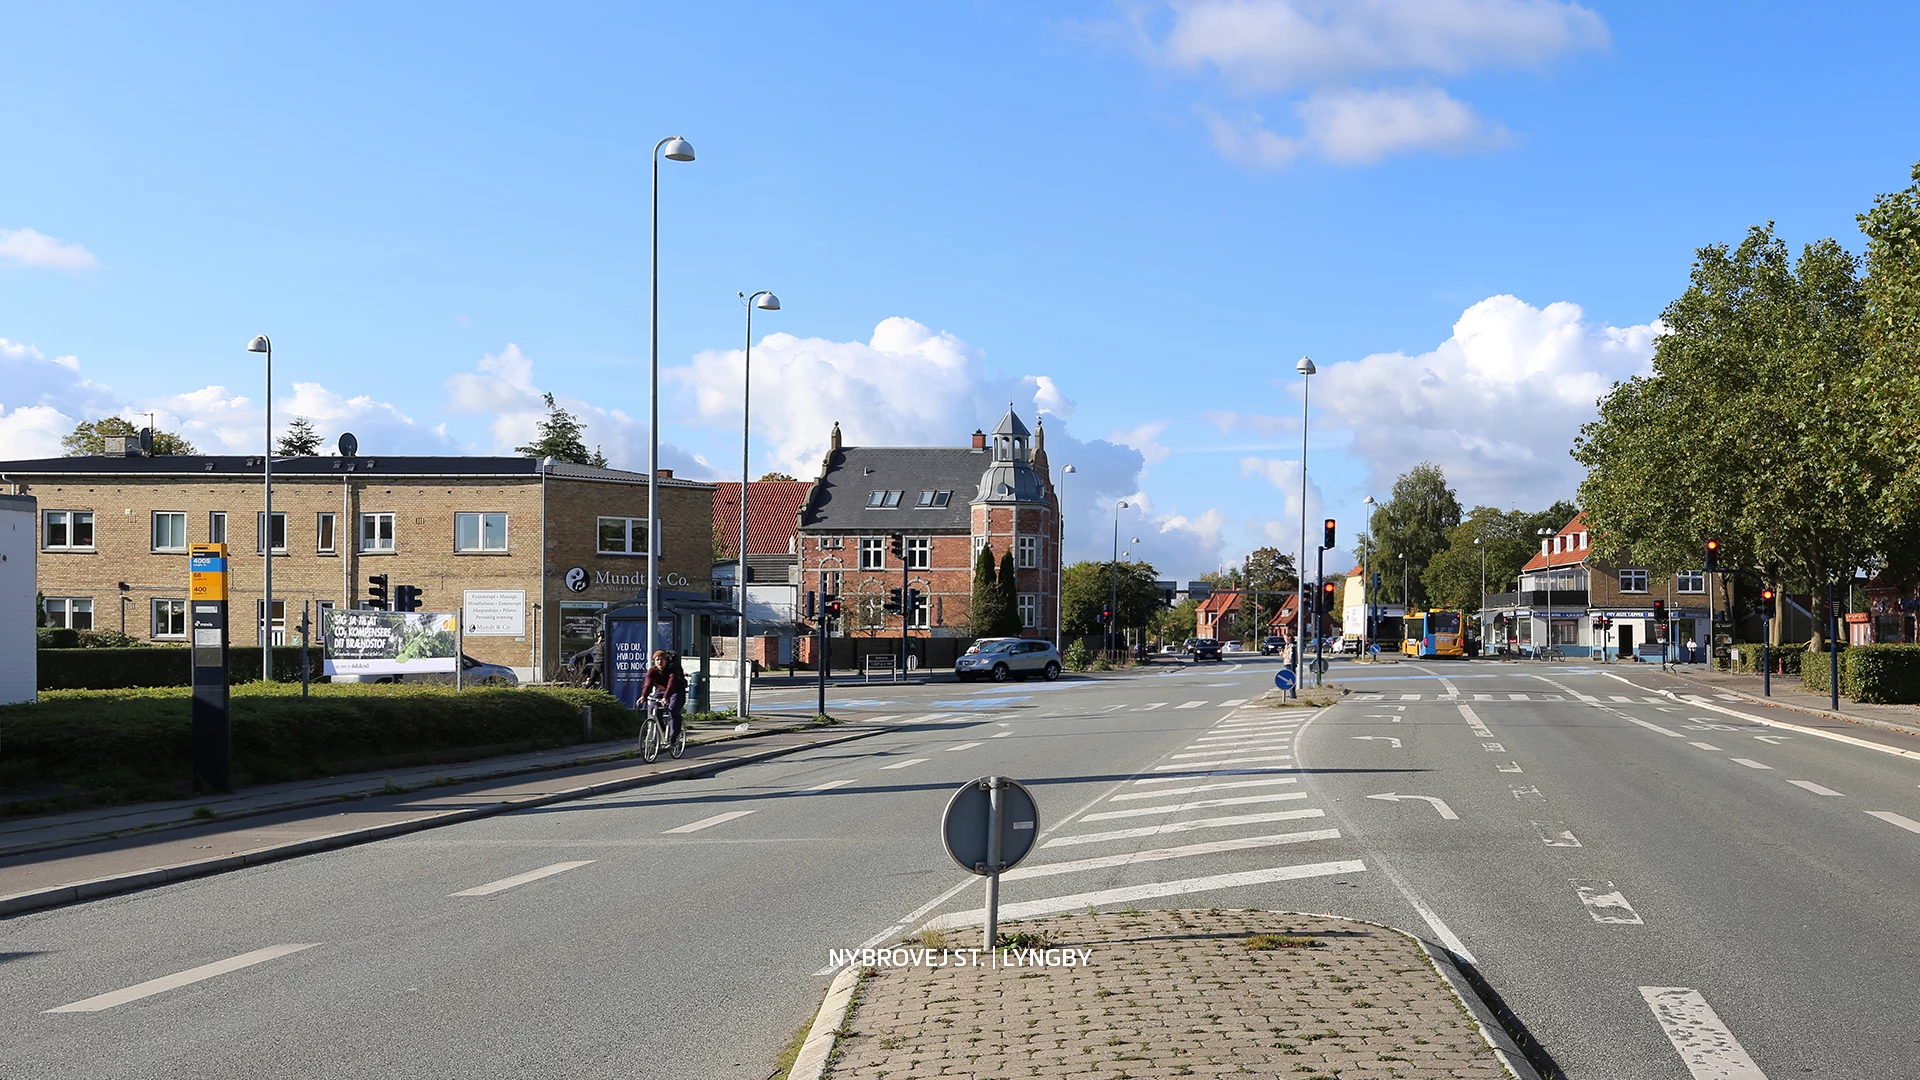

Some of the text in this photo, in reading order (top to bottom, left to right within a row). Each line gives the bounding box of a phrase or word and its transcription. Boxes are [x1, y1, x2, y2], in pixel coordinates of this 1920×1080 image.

[595, 570, 645, 585] Mundt
[667, 572, 690, 586] Co.
[334, 614, 347, 625] SIG
[348, 627, 391, 637] KOMPENSERE
[334, 638, 386, 648] DIT BRÆNDSTOF
[630, 643, 641, 652] DU,
